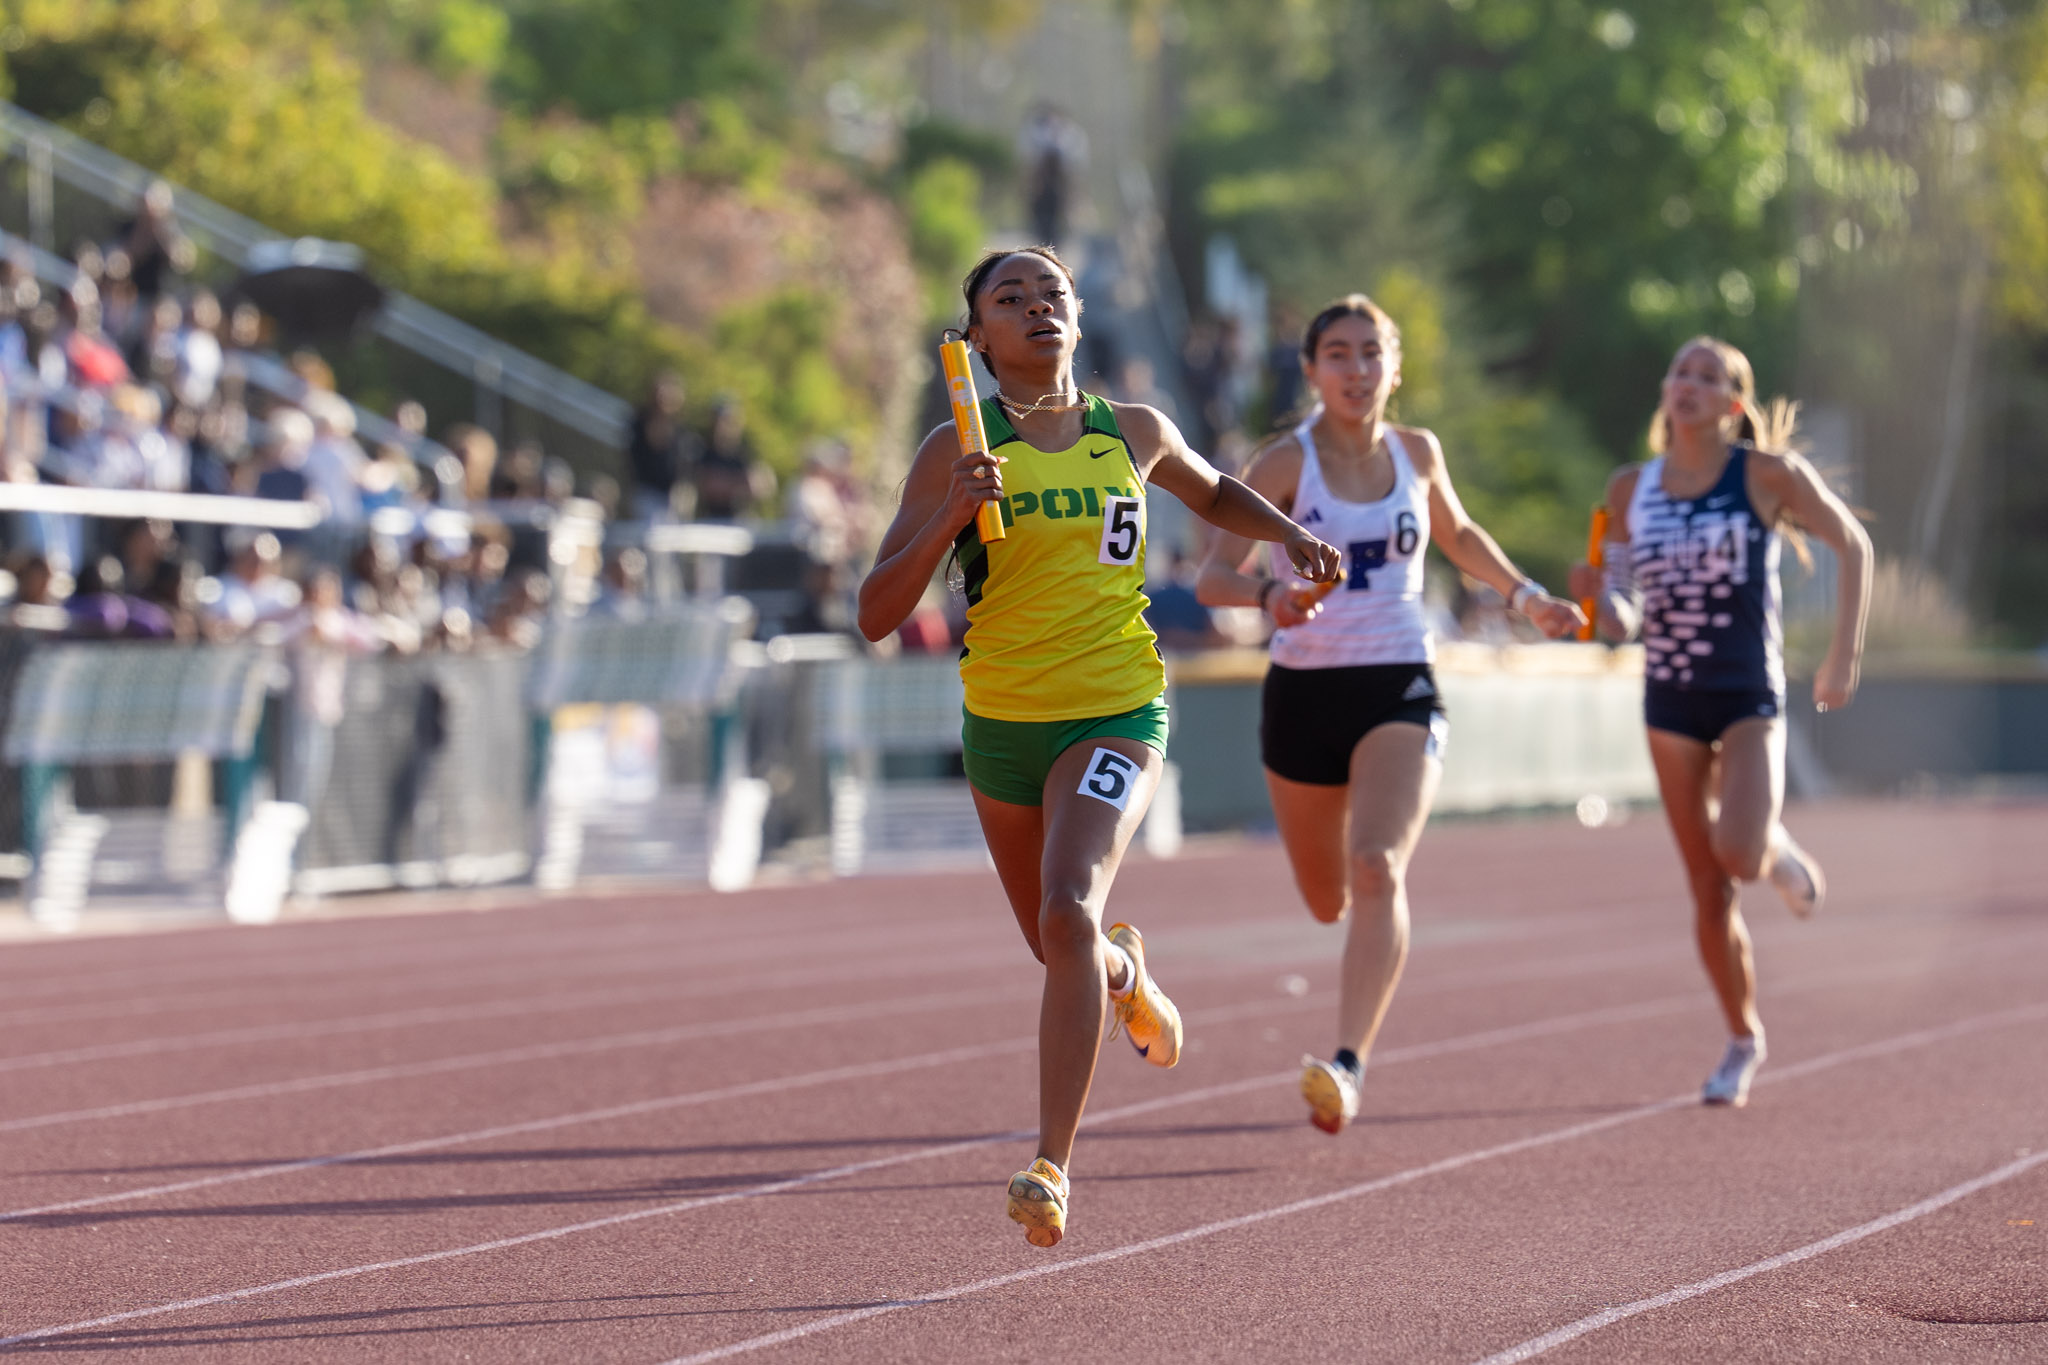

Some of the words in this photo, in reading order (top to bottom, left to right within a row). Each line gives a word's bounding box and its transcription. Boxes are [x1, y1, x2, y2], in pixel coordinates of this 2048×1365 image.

[1107, 501, 1139, 561] 5
[1396, 511, 1418, 555] 6
[1088, 752, 1132, 800] 5
